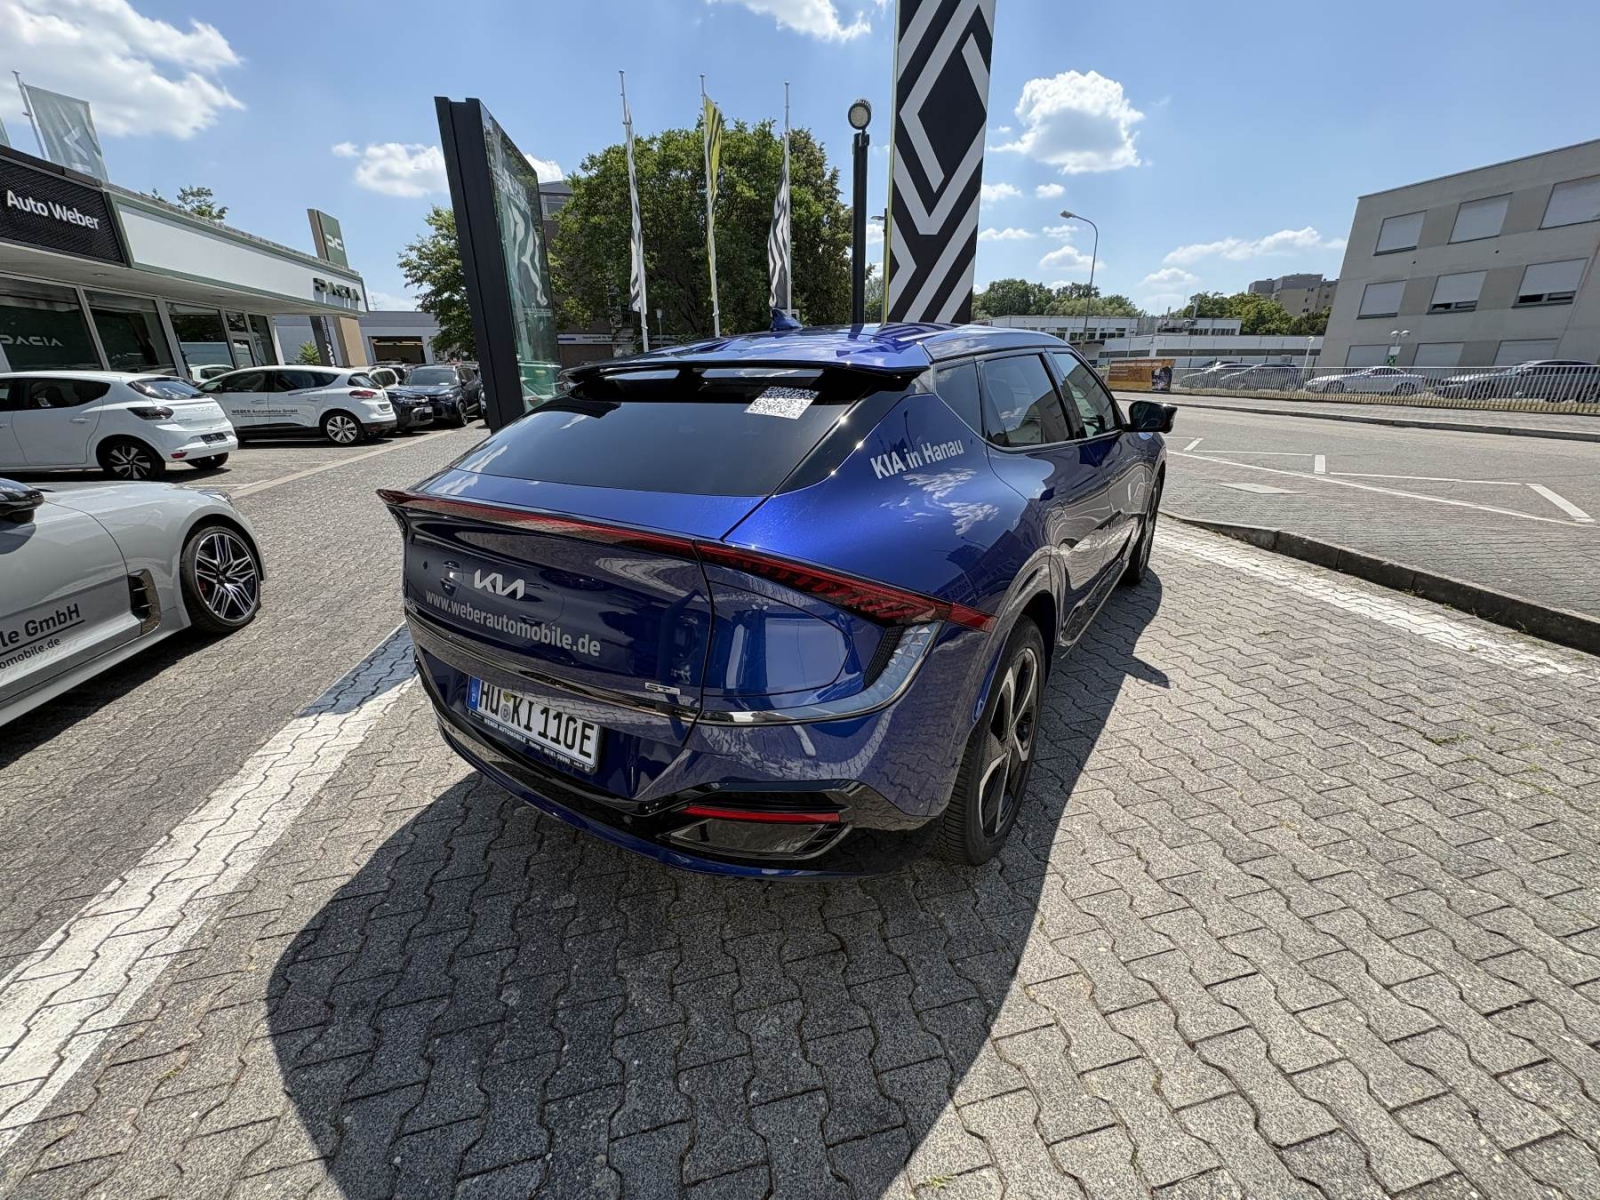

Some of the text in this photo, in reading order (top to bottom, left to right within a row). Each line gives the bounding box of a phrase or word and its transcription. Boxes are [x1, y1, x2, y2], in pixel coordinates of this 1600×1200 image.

[7, 190, 99, 229] Auto Weber
[870, 439, 964, 479] KIA in Hanau
[474, 569, 525, 599] KIA
[24, 603, 80, 637] GmbH
[425, 589, 600, 657] www.weberautomobile.de
